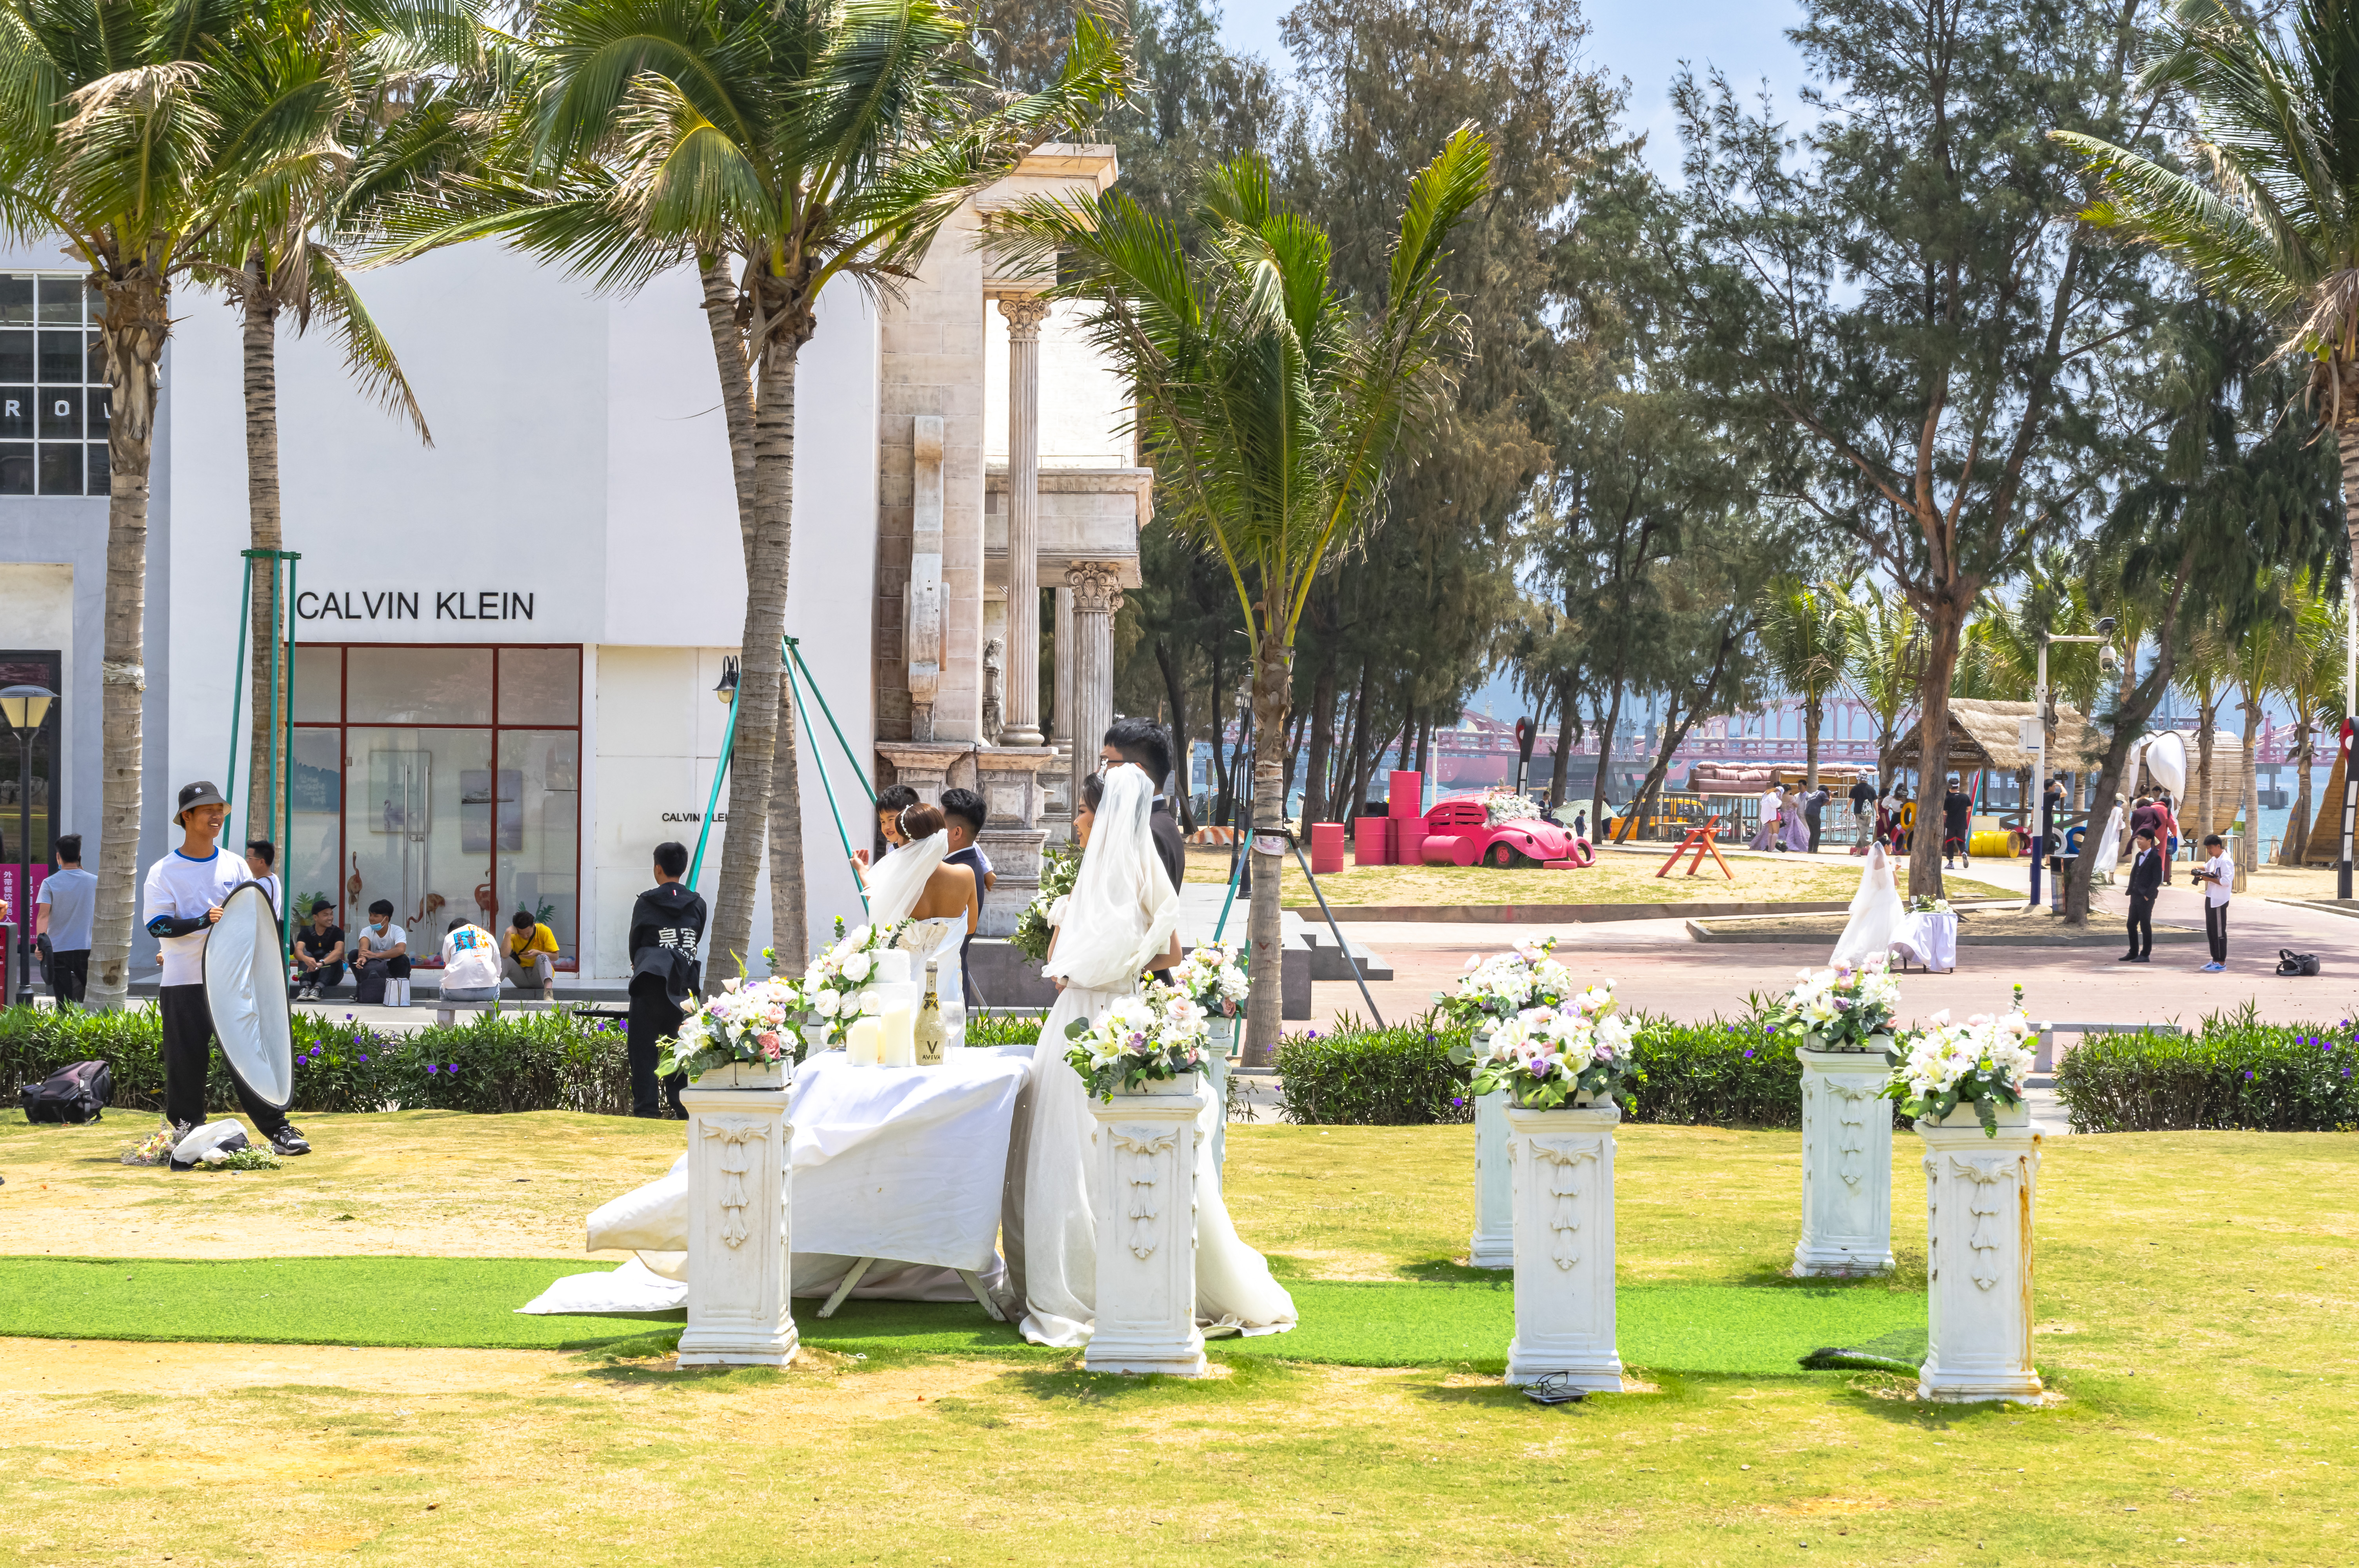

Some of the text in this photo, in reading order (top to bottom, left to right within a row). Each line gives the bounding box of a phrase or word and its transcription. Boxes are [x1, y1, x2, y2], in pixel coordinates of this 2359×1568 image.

[296, 591, 534, 620] CALVIN KLEIN
[662, 813, 700, 822] CALVIN
[927, 1041, 938, 1054] V
